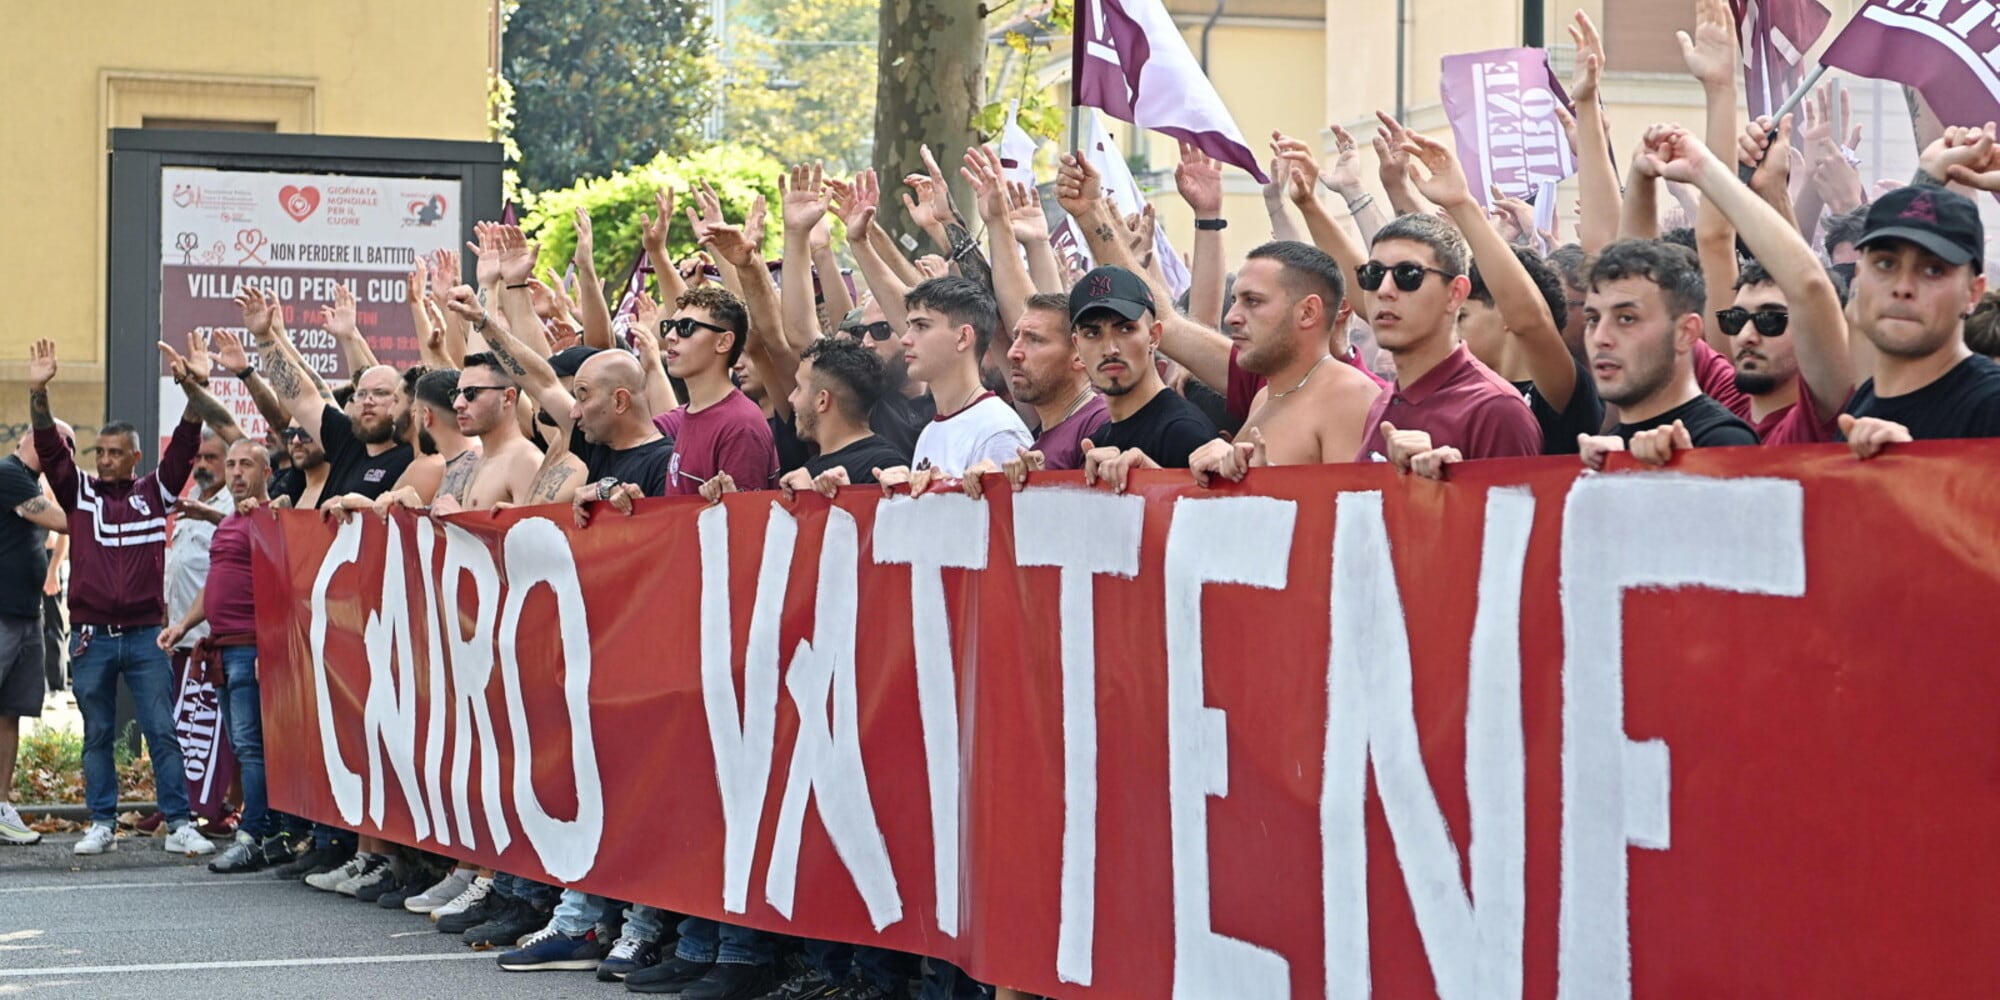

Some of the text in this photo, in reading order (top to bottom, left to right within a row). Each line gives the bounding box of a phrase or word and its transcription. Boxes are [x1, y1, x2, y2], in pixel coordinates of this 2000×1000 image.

[327, 186, 377, 196] GIORNATA
[327, 197, 378, 206] MONDIALE
[327, 206, 355, 215] PER IL
[326, 217, 361, 225] CUORE
[270, 243, 415, 264] NON PERDERE IL BATTITO
[300, 277, 336, 301] PER
[299, 329, 337, 349] 2025
[310, 507, 604, 883] CAIRO
